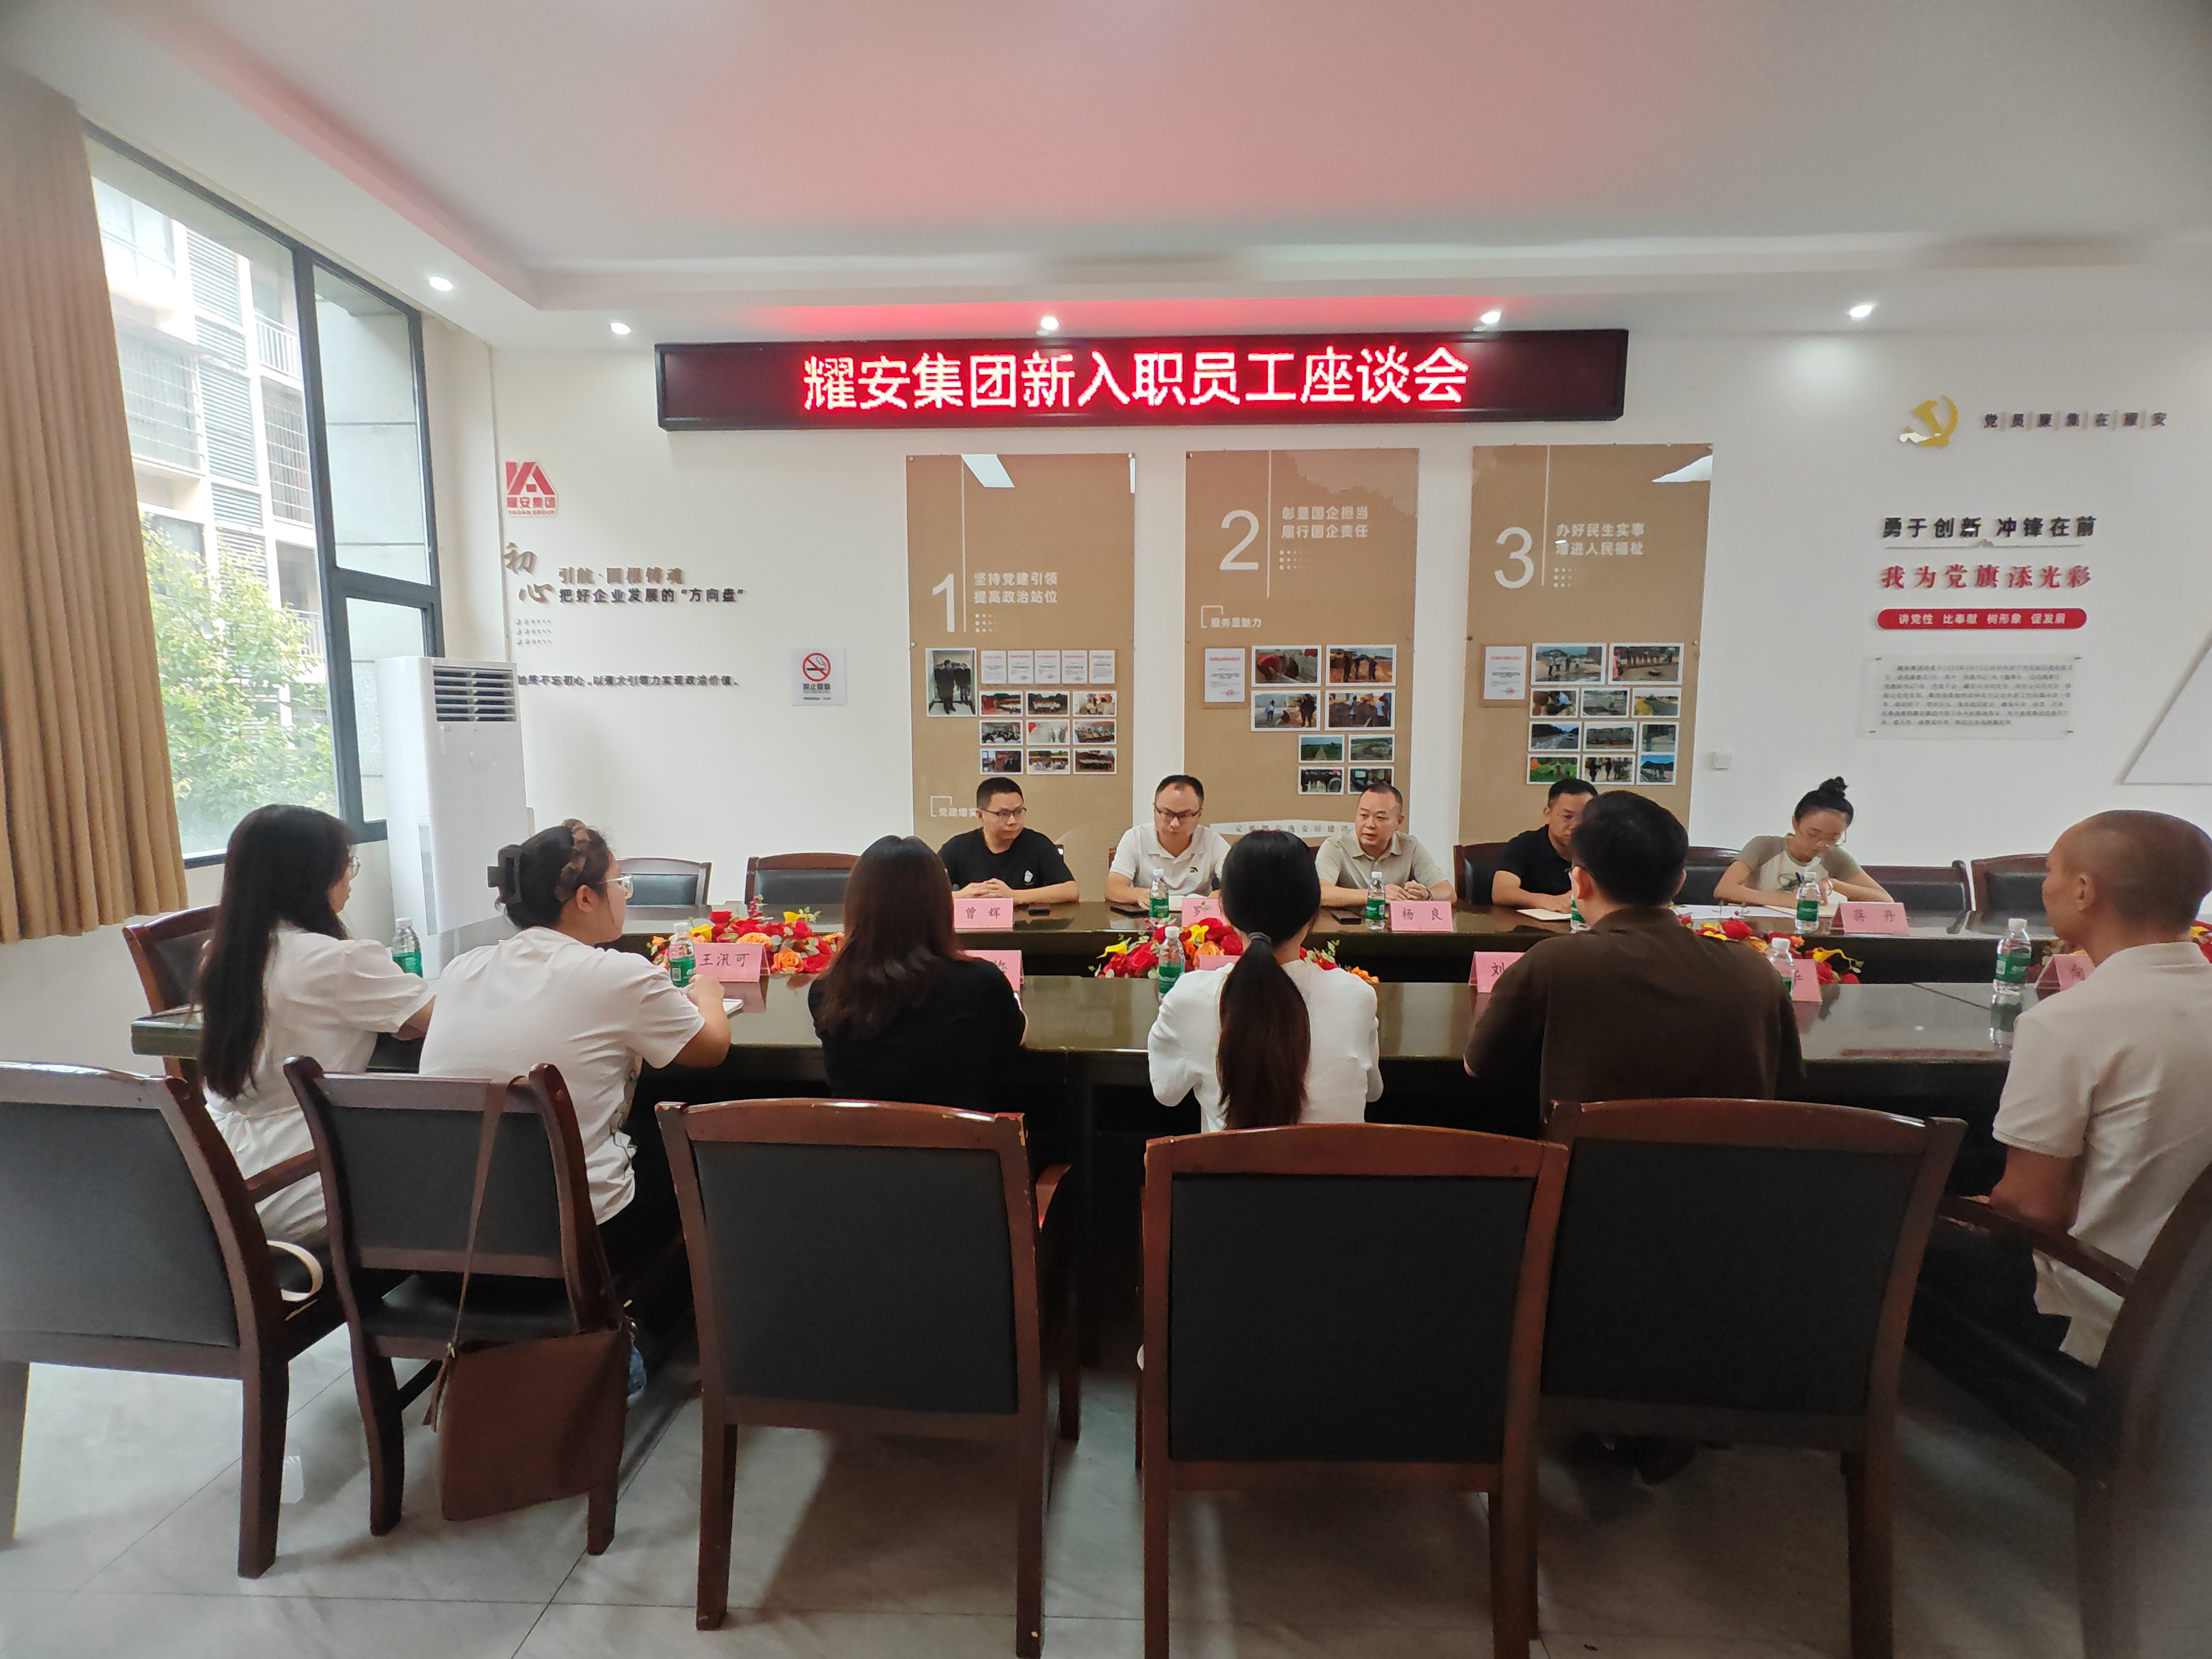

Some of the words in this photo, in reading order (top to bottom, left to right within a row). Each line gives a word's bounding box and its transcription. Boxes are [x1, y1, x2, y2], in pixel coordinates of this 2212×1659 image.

[803, 345, 1469, 410] 耀安集团新入职员工座谈会
[1281, 525, 1369, 539] 履行国企责任
[1556, 523, 1645, 538] 办好民生实事
[1882, 517, 1982, 538] 勇于创新
[1996, 516, 2097, 538] 冲锋在前
[1219, 510, 1259, 571] 2
[1494, 526, 1535, 588] 3
[973, 572, 1058, 586] 坚持党建引领
[1882, 564, 2092, 589] 我为党旗添光彩
[932, 573, 955, 633] 1
[974, 590, 1057, 604] 提高政治站位
[1898, 613, 1934, 625] 讲党性
[2031, 613, 2066, 624] 促发展
[1401, 907, 1443, 921] 杨良
